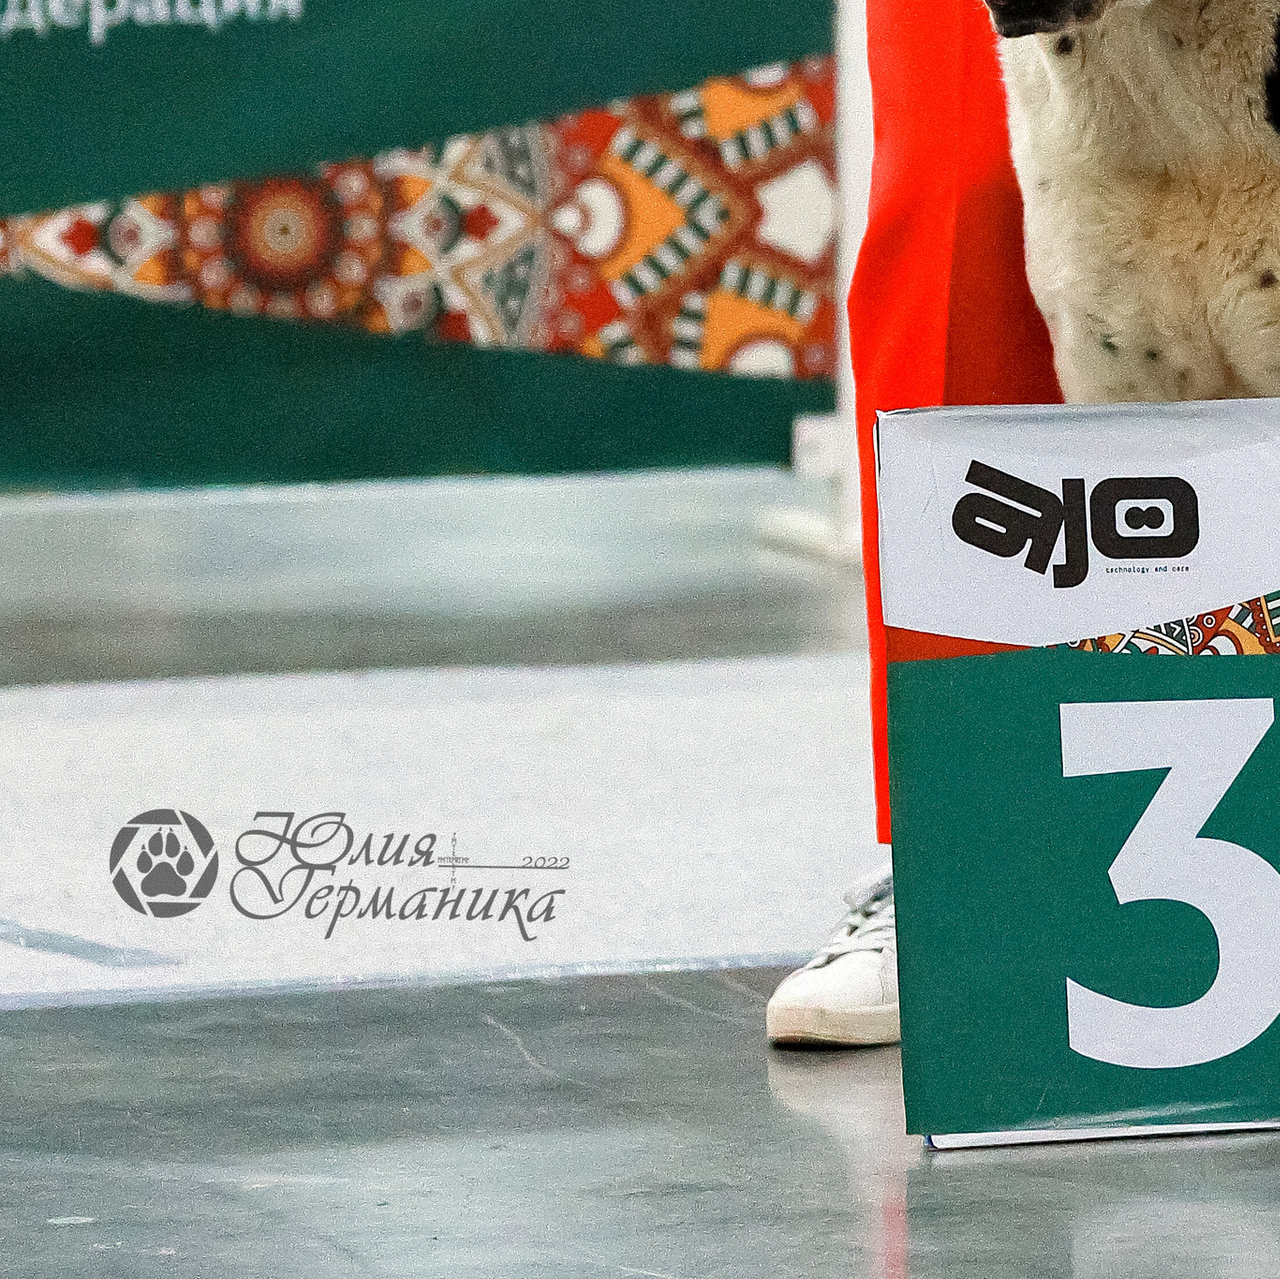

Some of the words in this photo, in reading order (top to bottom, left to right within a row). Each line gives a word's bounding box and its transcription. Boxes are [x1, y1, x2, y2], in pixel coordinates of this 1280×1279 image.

[1105, 565, 1150, 574] technology
[1154, 565, 1168, 573] and
[1171, 565, 1190, 573] care
